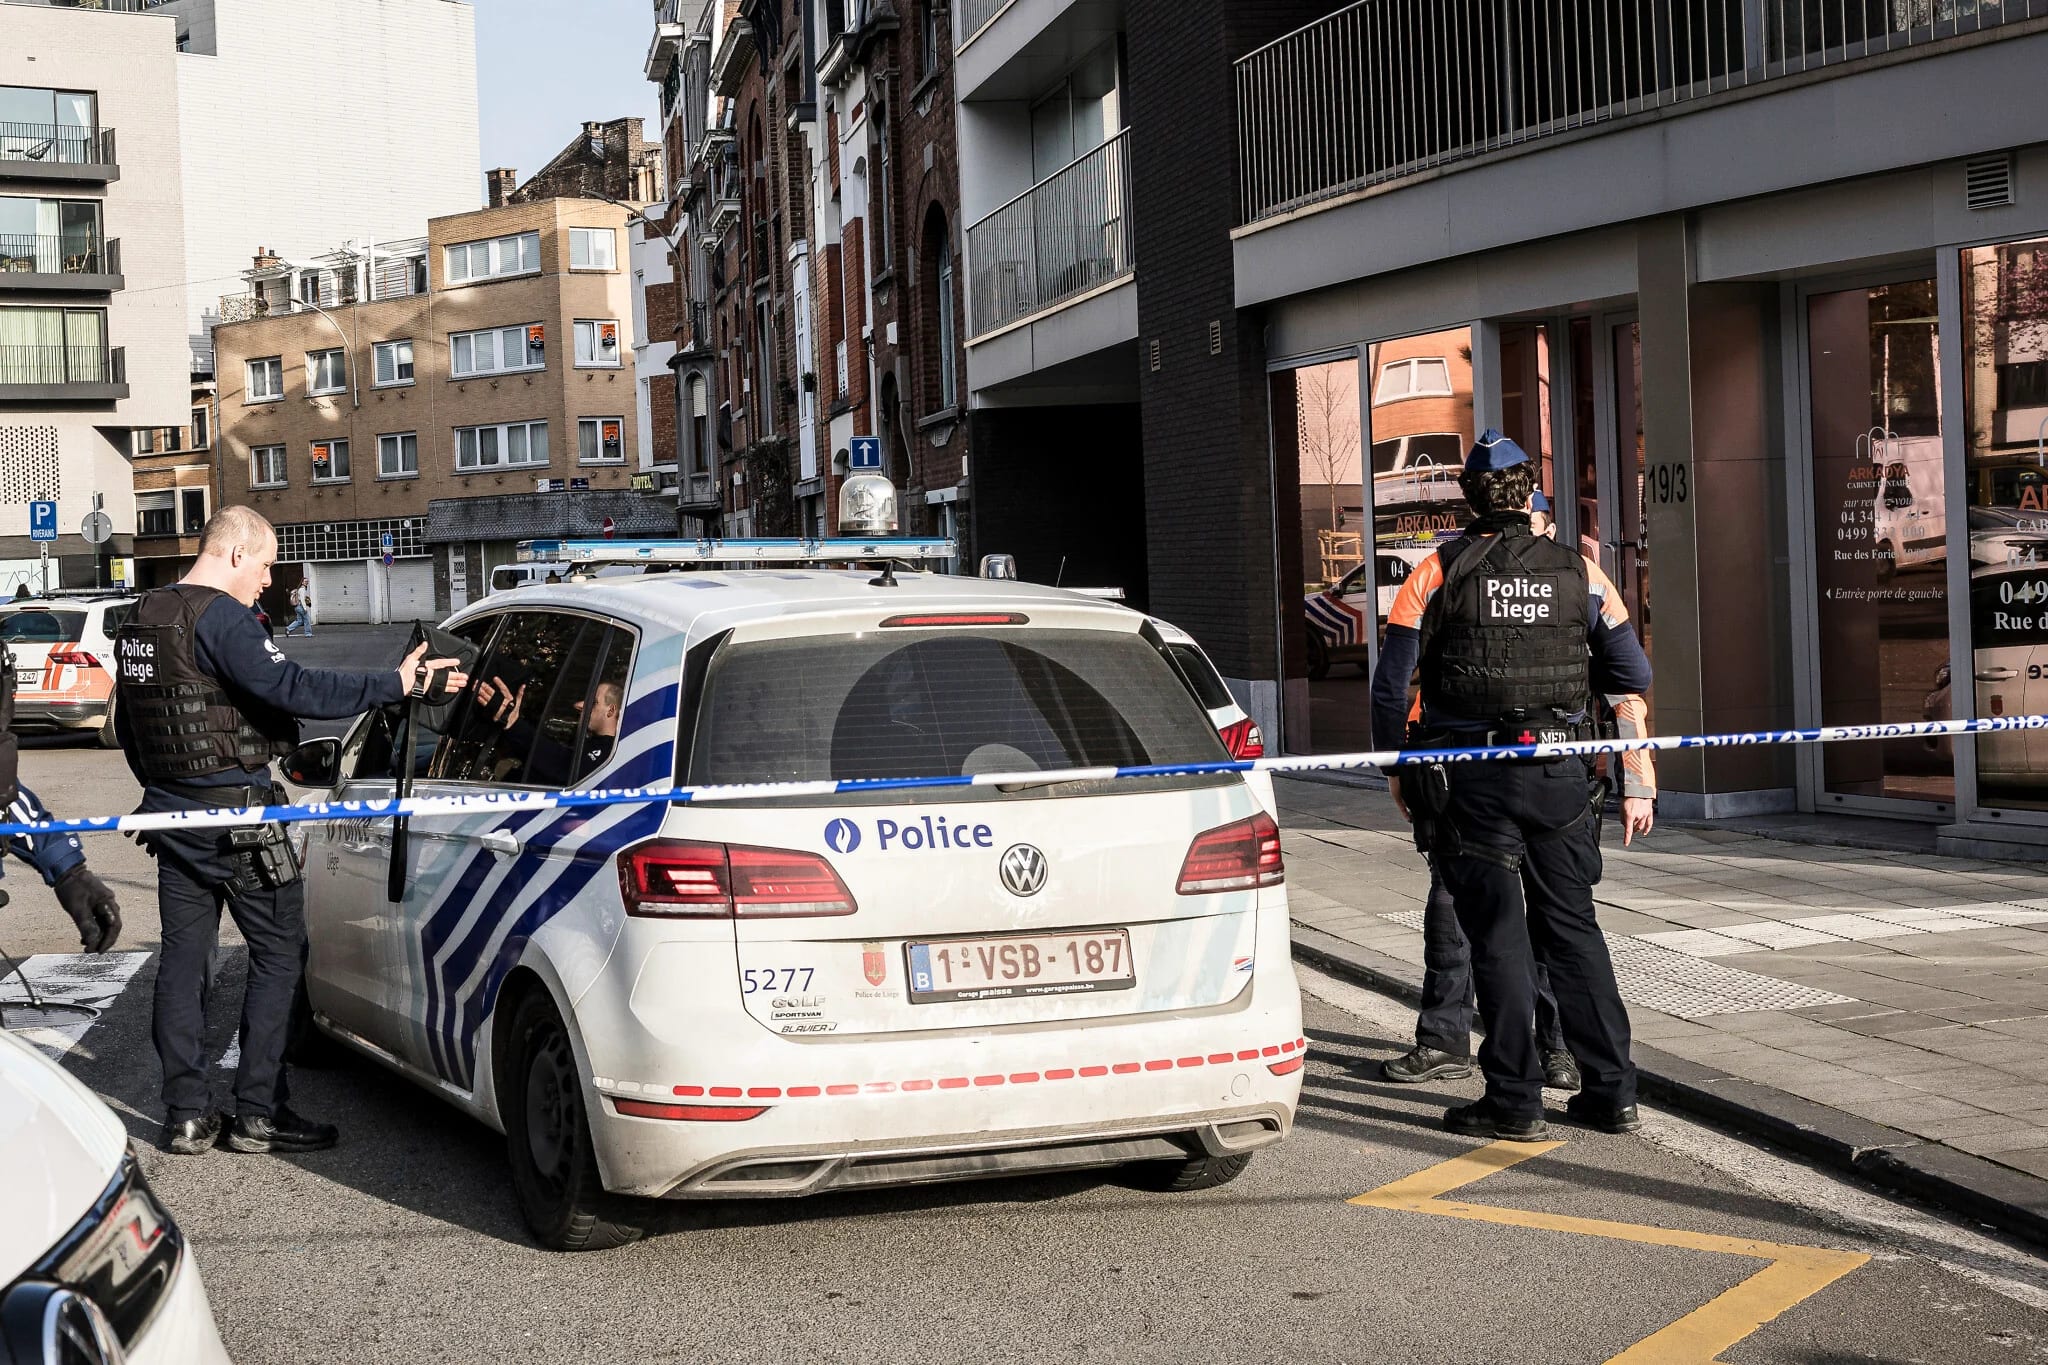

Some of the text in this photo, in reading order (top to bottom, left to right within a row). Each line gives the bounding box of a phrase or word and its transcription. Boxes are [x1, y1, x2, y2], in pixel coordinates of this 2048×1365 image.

[1848, 465, 1910, 480] ARKADYA
[1648, 463, 1687, 504] 19/3
[36, 504, 51, 525] P
[1841, 512, 1855, 523] 04
[32, 528, 55, 538] RIVERAINS
[1396, 515, 1457, 534] ARKADYA
[1837, 527, 1868, 540] 0499
[1834, 550, 1852, 560] Rue
[1854, 549, 1869, 560] des
[2007, 547, 2036, 570] 04
[1390, 560, 1404, 578] 04
[1487, 578, 1552, 597] Police
[1835, 587, 1944, 602] Entrée porte de gauche
[1490, 599, 1550, 623] Liege
[1993, 611, 2033, 630] Rue
[121, 638, 154, 657] Police
[123, 659, 154, 682] Liege
[877, 815, 993, 851] Police
[744, 967, 815, 994] 5277
[916, 972, 930, 988] B
[772, 995, 826, 1009] GOLF
[957, 991, 979, 999] Garage
[781, 1024, 828, 1033] BLAVIER
